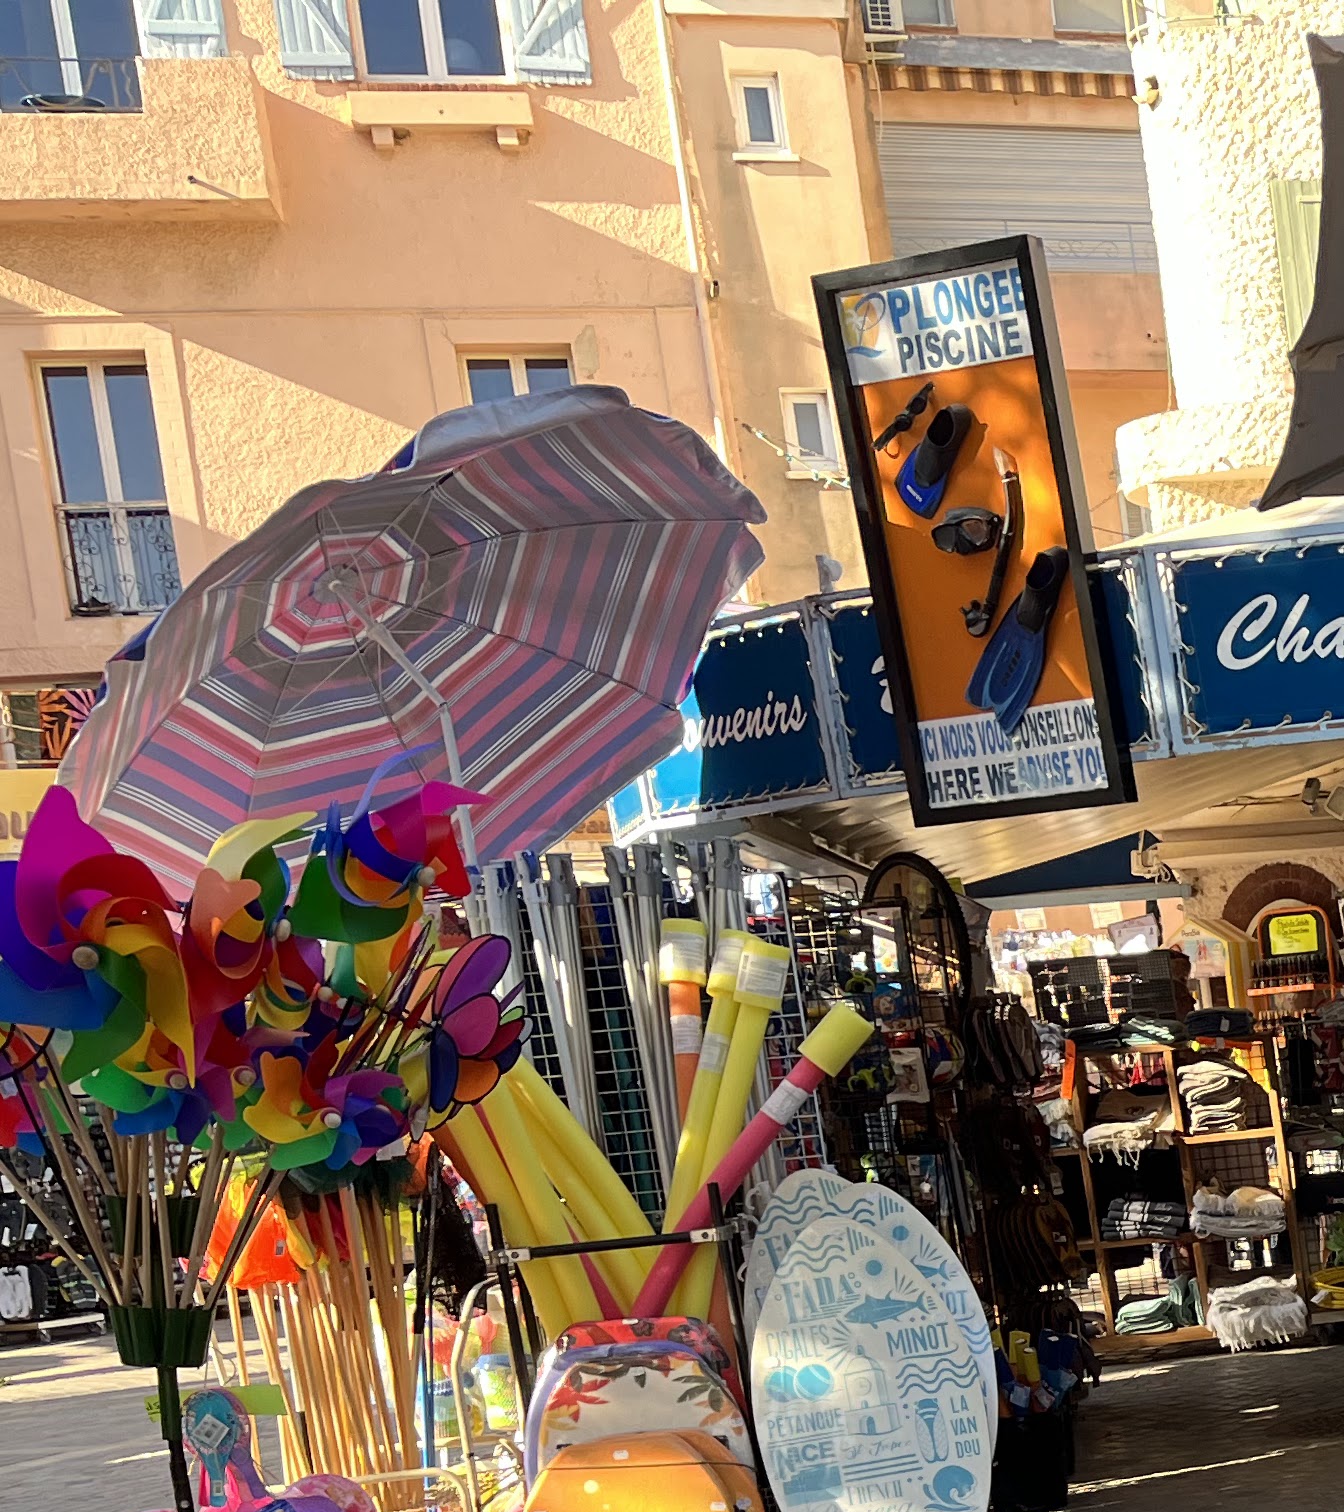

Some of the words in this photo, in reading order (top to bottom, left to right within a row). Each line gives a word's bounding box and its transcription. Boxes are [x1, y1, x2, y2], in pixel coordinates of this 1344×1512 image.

[896, 317, 1024, 374] PISCINE
[683, 690, 807, 752] ouvenirs
[941, 720, 977, 760] NOUS
[926, 766, 984, 803] HERE
[765, 1323, 831, 1363] CIGALES
[885, 1322, 949, 1358] MINOT
[950, 1395, 970, 1414] LA
[950, 1416, 979, 1436] VAN
[955, 1439, 981, 1459] DOU
